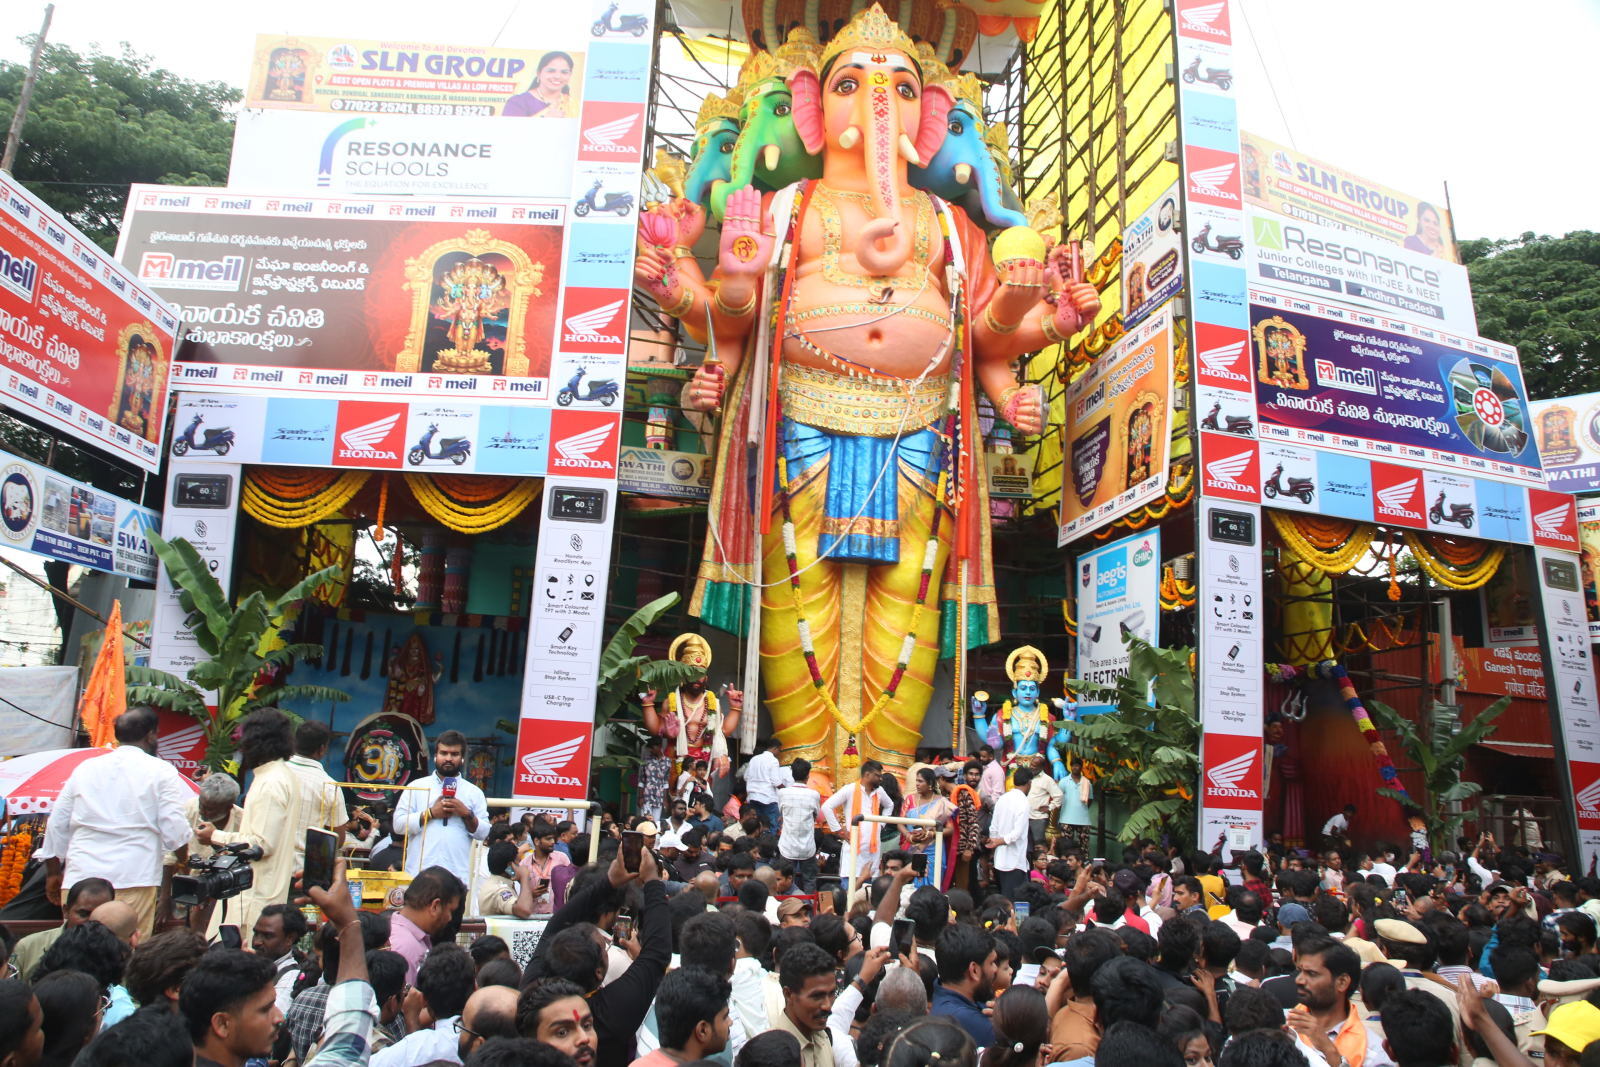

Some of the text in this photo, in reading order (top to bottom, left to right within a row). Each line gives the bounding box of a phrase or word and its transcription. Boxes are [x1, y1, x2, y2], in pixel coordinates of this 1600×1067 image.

[1182, 23, 1228, 37] HONDA
[361, 50, 525, 79] SLN GROUP
[352, 77, 370, 86] OPEN
[371, 78, 394, 87] PLOTS
[403, 80, 436, 89] PREMIUM
[437, 81, 461, 90] VILLAS
[347, 141, 492, 159] RESONANCE
[583, 143, 638, 154] HONDA
[345, 161, 448, 177] SCHOOLS
[432, 181, 488, 190] EXCELLENCE
[1191, 187, 1239, 201] HONDA
[1296, 162, 1338, 194] SLN
[1341, 180, 1409, 219] GROUP
[159, 197, 559, 220] meil meil meil meil meil meil meil
[10, 197, 31, 219] meil
[48, 226, 66, 245] meil
[81, 252, 97, 270] meil
[111, 274, 125, 292] meil
[177, 258, 241, 281] meil
[1257, 249, 1293, 265] Junior
[1296, 257, 1344, 278] Colleges
[1347, 269, 1369, 283] with
[1407, 283, 1414, 294] &
[1416, 285, 1440, 302] NEET
[1272, 266, 1437, 317] Telangana Andhra Pradesh
[267, 306, 325, 329] చవితి
[1259, 294, 1277, 304] meil
[1294, 301, 1311, 311] meil
[1326, 307, 1343, 318] meil
[1359, 314, 1375, 325] meil
[1150, 316, 1164, 333] meil
[186, 325, 295, 351] శుభాకాంక్షలు
[564, 333, 623, 344] HONDA
[46, 334, 80, 370] చవితి
[185, 367, 541, 393] meil meil meil meil meil meil
[1200, 367, 1249, 382] HONDA
[1339, 368, 1374, 388] meil
[1085, 380, 1105, 412] meil
[19, 382, 39, 399] meil
[55, 400, 73, 416] meil
[87, 416, 103, 432] meil
[116, 431, 131, 445] meil
[1277, 391, 1333, 415] వినాయక
[1336, 399, 1370, 421] చవితి
[1373, 406, 1449, 436] శుభాకాంక్షలు
[1271, 427, 1455, 462] meil meil meil meil meil meil
[339, 449, 398, 460] HONDA
[554, 458, 613, 469] HONDA
[1206, 480, 1256, 494] HONDA
[1378, 506, 1423, 520] HONDA
[1536, 530, 1575, 542] HONDA
[1134, 552, 1151, 565] GHMC
[1097, 561, 1126, 587] aegis
[1504, 627, 1523, 637] meil
[1089, 659, 1099, 668] This
[1100, 658, 1111, 667] area
[1484, 661, 1516, 675] Ganesh
[1504, 678, 1546, 698] गणेश मंदिर
[520, 773, 582, 787] HONDA
[1208, 787, 1258, 798] HONDA
